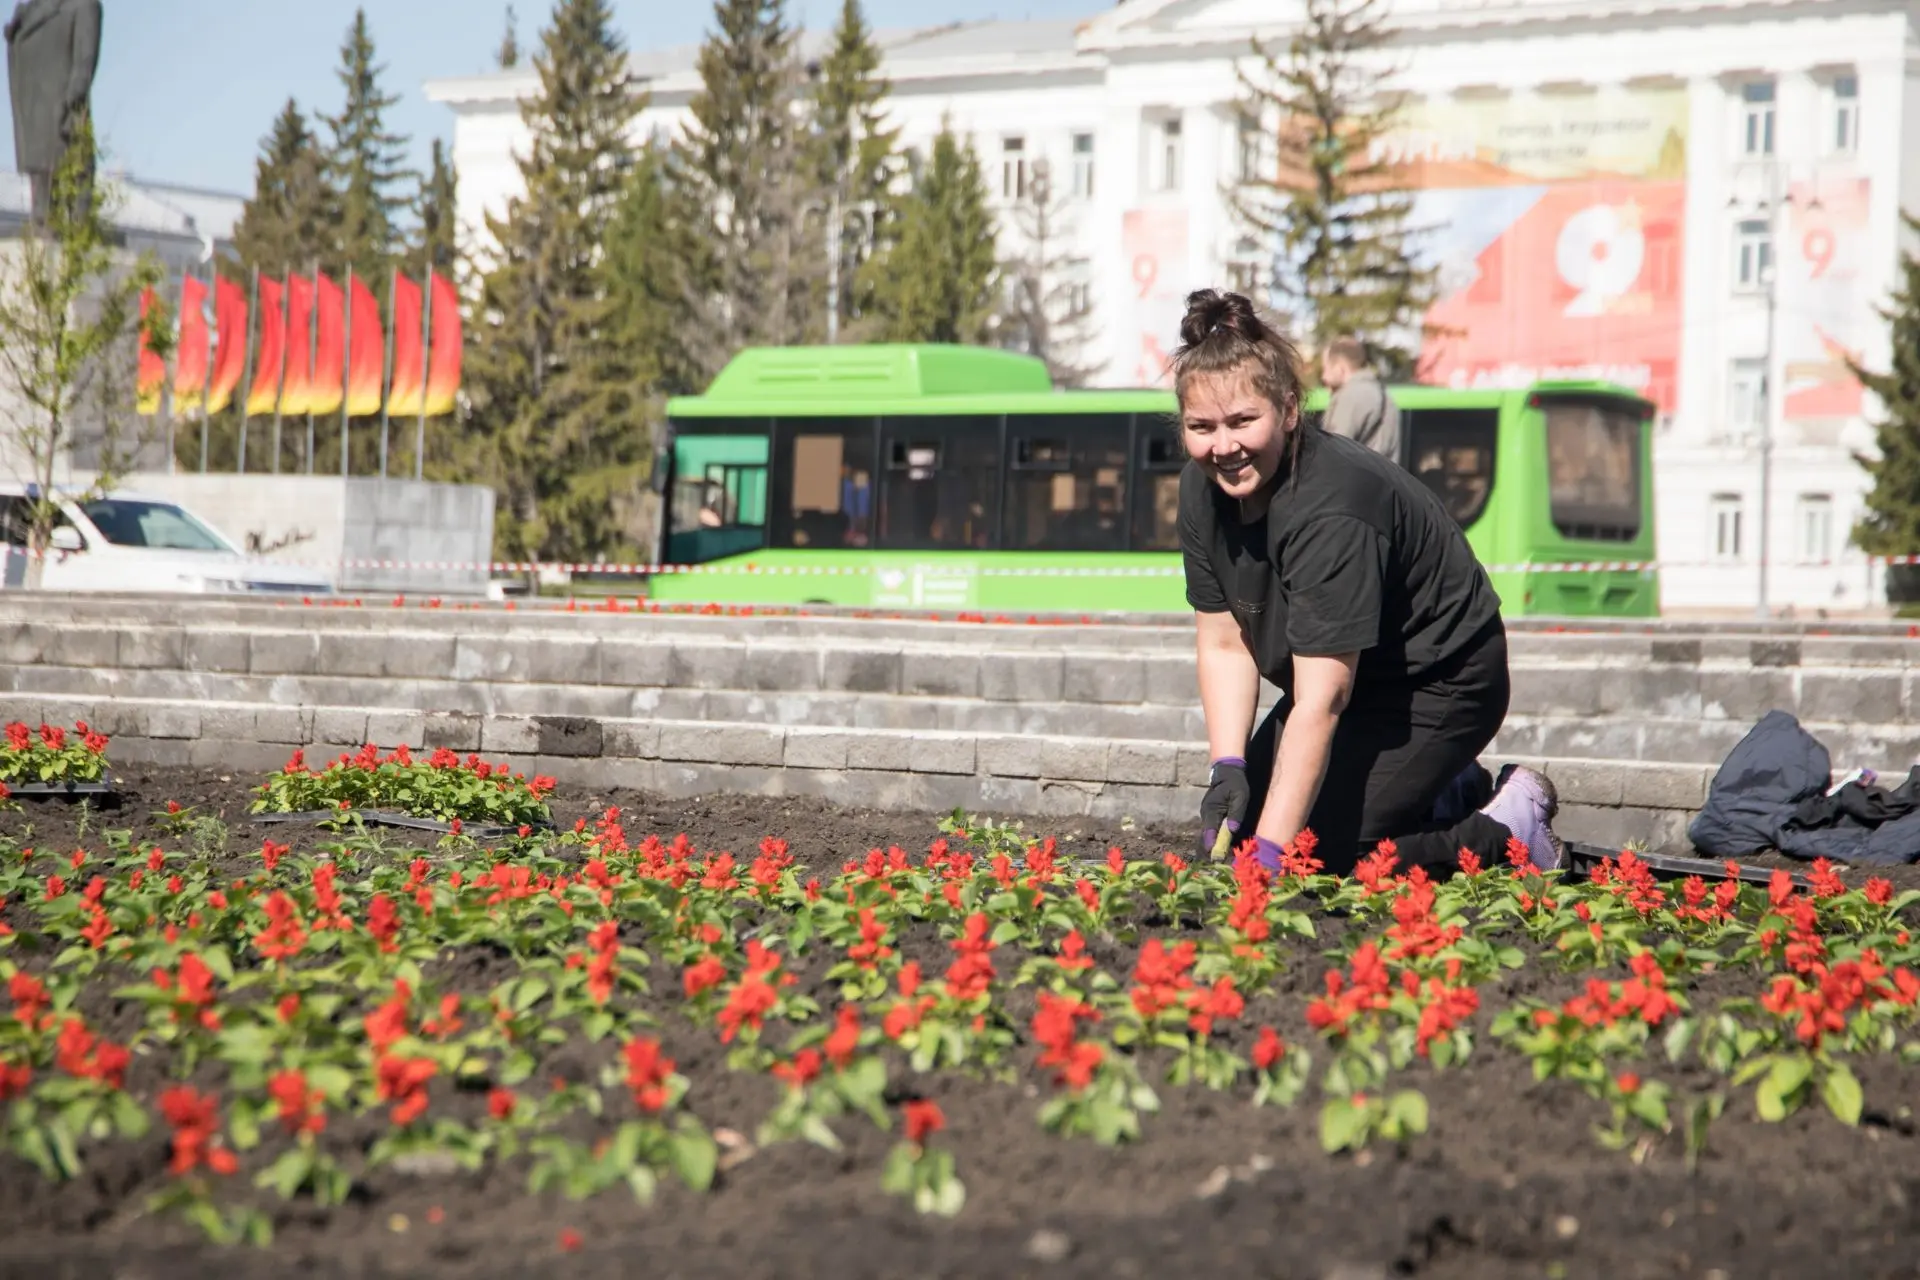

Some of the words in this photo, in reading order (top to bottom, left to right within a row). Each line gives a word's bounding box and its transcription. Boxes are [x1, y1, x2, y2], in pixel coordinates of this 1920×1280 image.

[1132, 254, 1158, 298] 9
[1558, 207, 1643, 315] 9
[1803, 229, 1834, 278] 9
